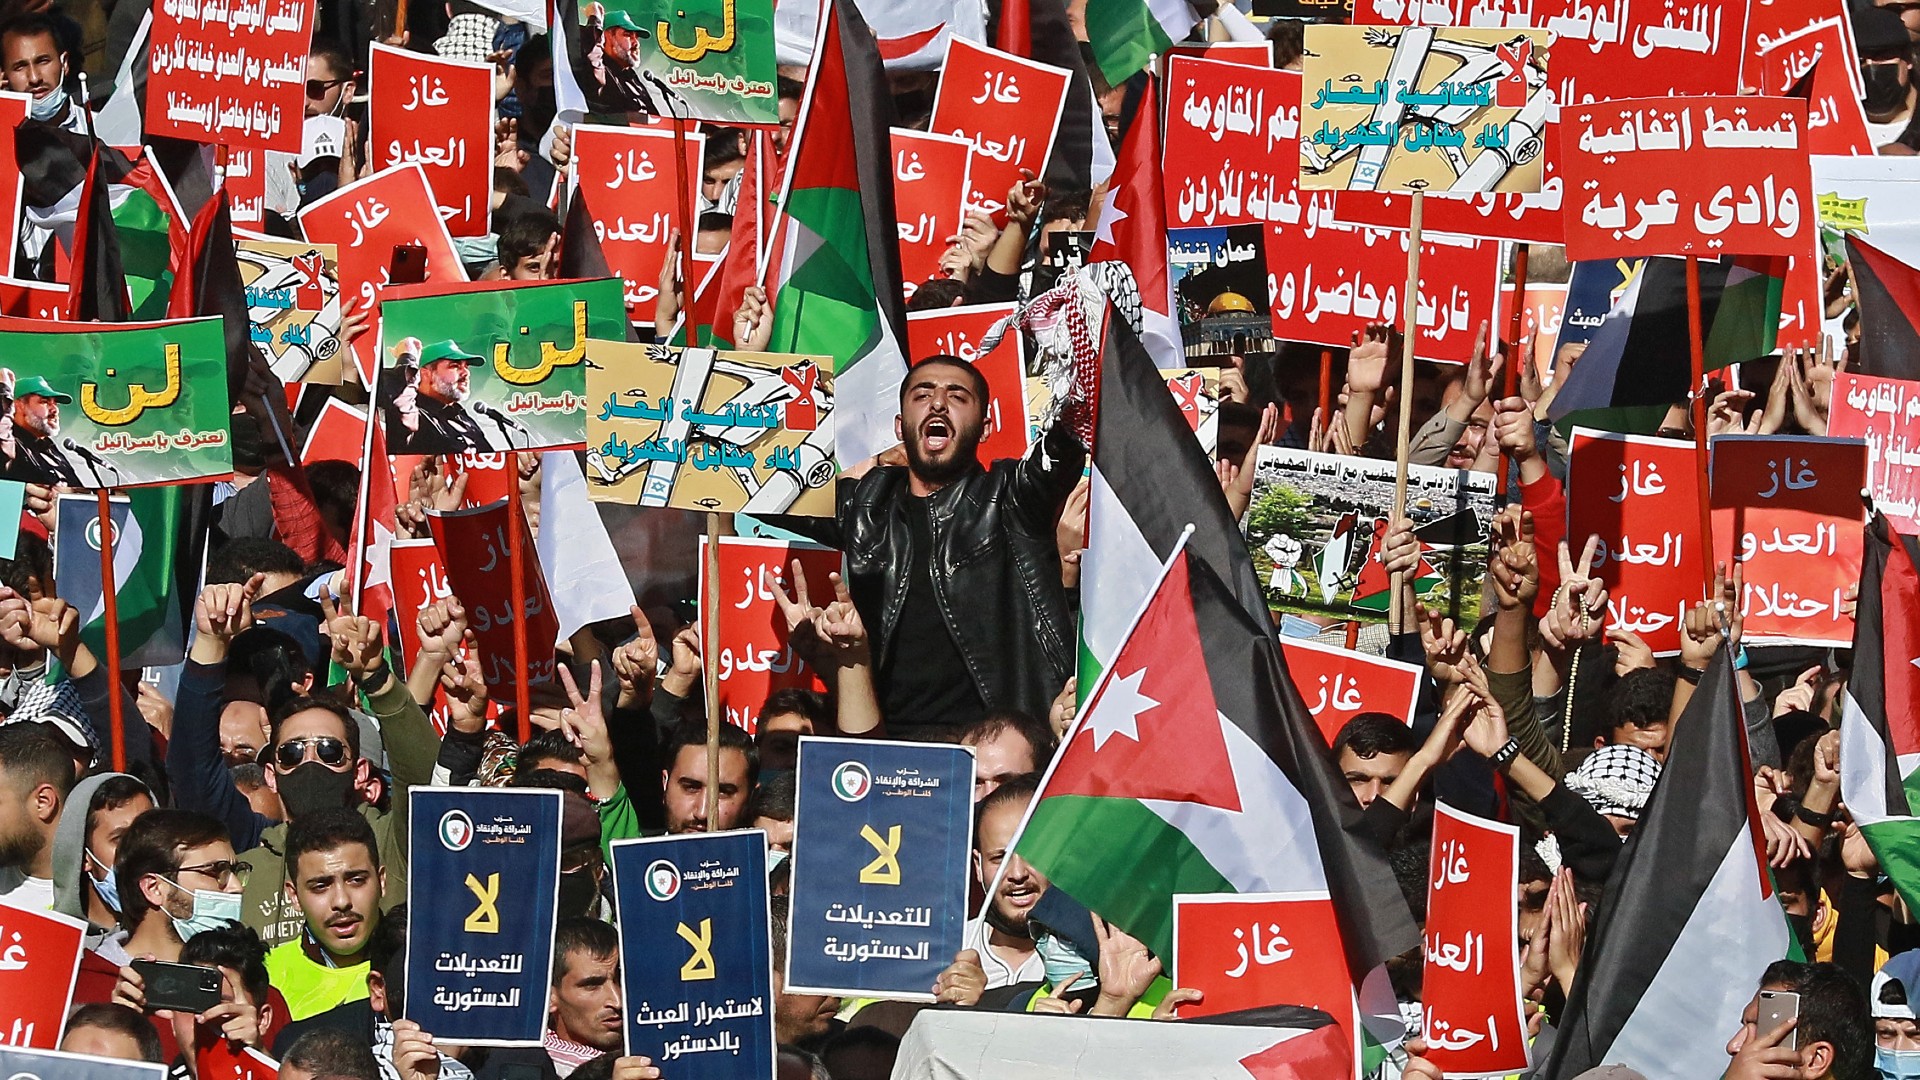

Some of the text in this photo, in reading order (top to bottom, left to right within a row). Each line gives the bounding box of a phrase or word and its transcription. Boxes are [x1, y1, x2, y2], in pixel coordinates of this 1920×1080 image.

[202, 0, 229, 31] لدعم
[228, 0, 265, 38] الوطني
[265, 0, 304, 36] الملتقى
[656, 0, 737, 63] لن
[1632, 3, 1722, 58] الملتقى
[152, 33, 307, 89] التطبيع مع العدو خيانة للأردن
[402, 73, 450, 111] غاز
[668, 69, 772, 97] نعترف بإسرائيل
[971, 70, 1021, 105] غاز
[1310, 78, 1492, 112] لاتفاقية العار
[166, 91, 281, 140] تاريخا وحاضرا ومستقبلا
[1182, 78, 1300, 154] عم المقاومة
[1807, 95, 1840, 131] الع
[385, 135, 466, 168] العدو
[1312, 119, 1510, 154] الماء مقابل الكهرباء
[1578, 106, 1799, 165] تسقط اتفاقية
[605, 148, 657, 190] غاز
[896, 149, 927, 183] غا
[1178, 158, 1245, 227] للأردن
[1247, 171, 1302, 236] خيانة
[1581, 178, 1680, 241] عربة
[1694, 174, 1801, 249] وادي
[345, 197, 391, 248] غاز
[594, 210, 671, 245] العدو
[896, 211, 937, 246] الع
[1214, 238, 1257, 269] عمان
[244, 286, 291, 310] لاتفاق
[1303, 262, 1398, 326] وحاضرا
[279, 325, 311, 346] الماء
[1568, 308, 1607, 330] لعبث
[493, 300, 588, 385] لن
[79, 343, 182, 426] لن
[507, 392, 577, 414] بإسرائيل
[781, 362, 820, 433] لا
[1847, 379, 1905, 418] المقاومة
[596, 391, 779, 432] لاتفاقية العار
[95, 432, 225, 452] نعترف بإسرائيل
[600, 431, 802, 472] الماء مقابل الكهرباء
[1258, 453, 1312, 474] الصهيوني
[1314, 461, 1342, 478] العدو
[1343, 466, 1358, 483] مع
[1608, 459, 1667, 503] غاز
[1758, 457, 1819, 498] غاز
[479, 524, 511, 572] از
[1590, 530, 1682, 569] العدو
[1735, 522, 1837, 563] العدو
[1605, 594, 1686, 634] احتلا
[1741, 581, 1842, 622] احتلال
[1309, 672, 1364, 716] غاز
[908, 777, 940, 788] الشراكة
[504, 824, 532, 836] الشراكة
[711, 867, 740, 880] الشراكة
[859, 824, 902, 886] لا
[1434, 838, 1470, 890] غاز
[464, 871, 501, 934] لا
[825, 903, 932, 930] للتعديلات
[435, 952, 524, 979] للتعديلات
[675, 917, 717, 981] لا
[823, 937, 930, 962] الدستورية
[1225, 922, 1294, 978] غاز
[1425, 930, 1484, 976] العد
[433, 987, 521, 1012] الدستورية
[636, 996, 764, 1030] لاستمرار العبث
[661, 1030, 741, 1061] بالدستور
